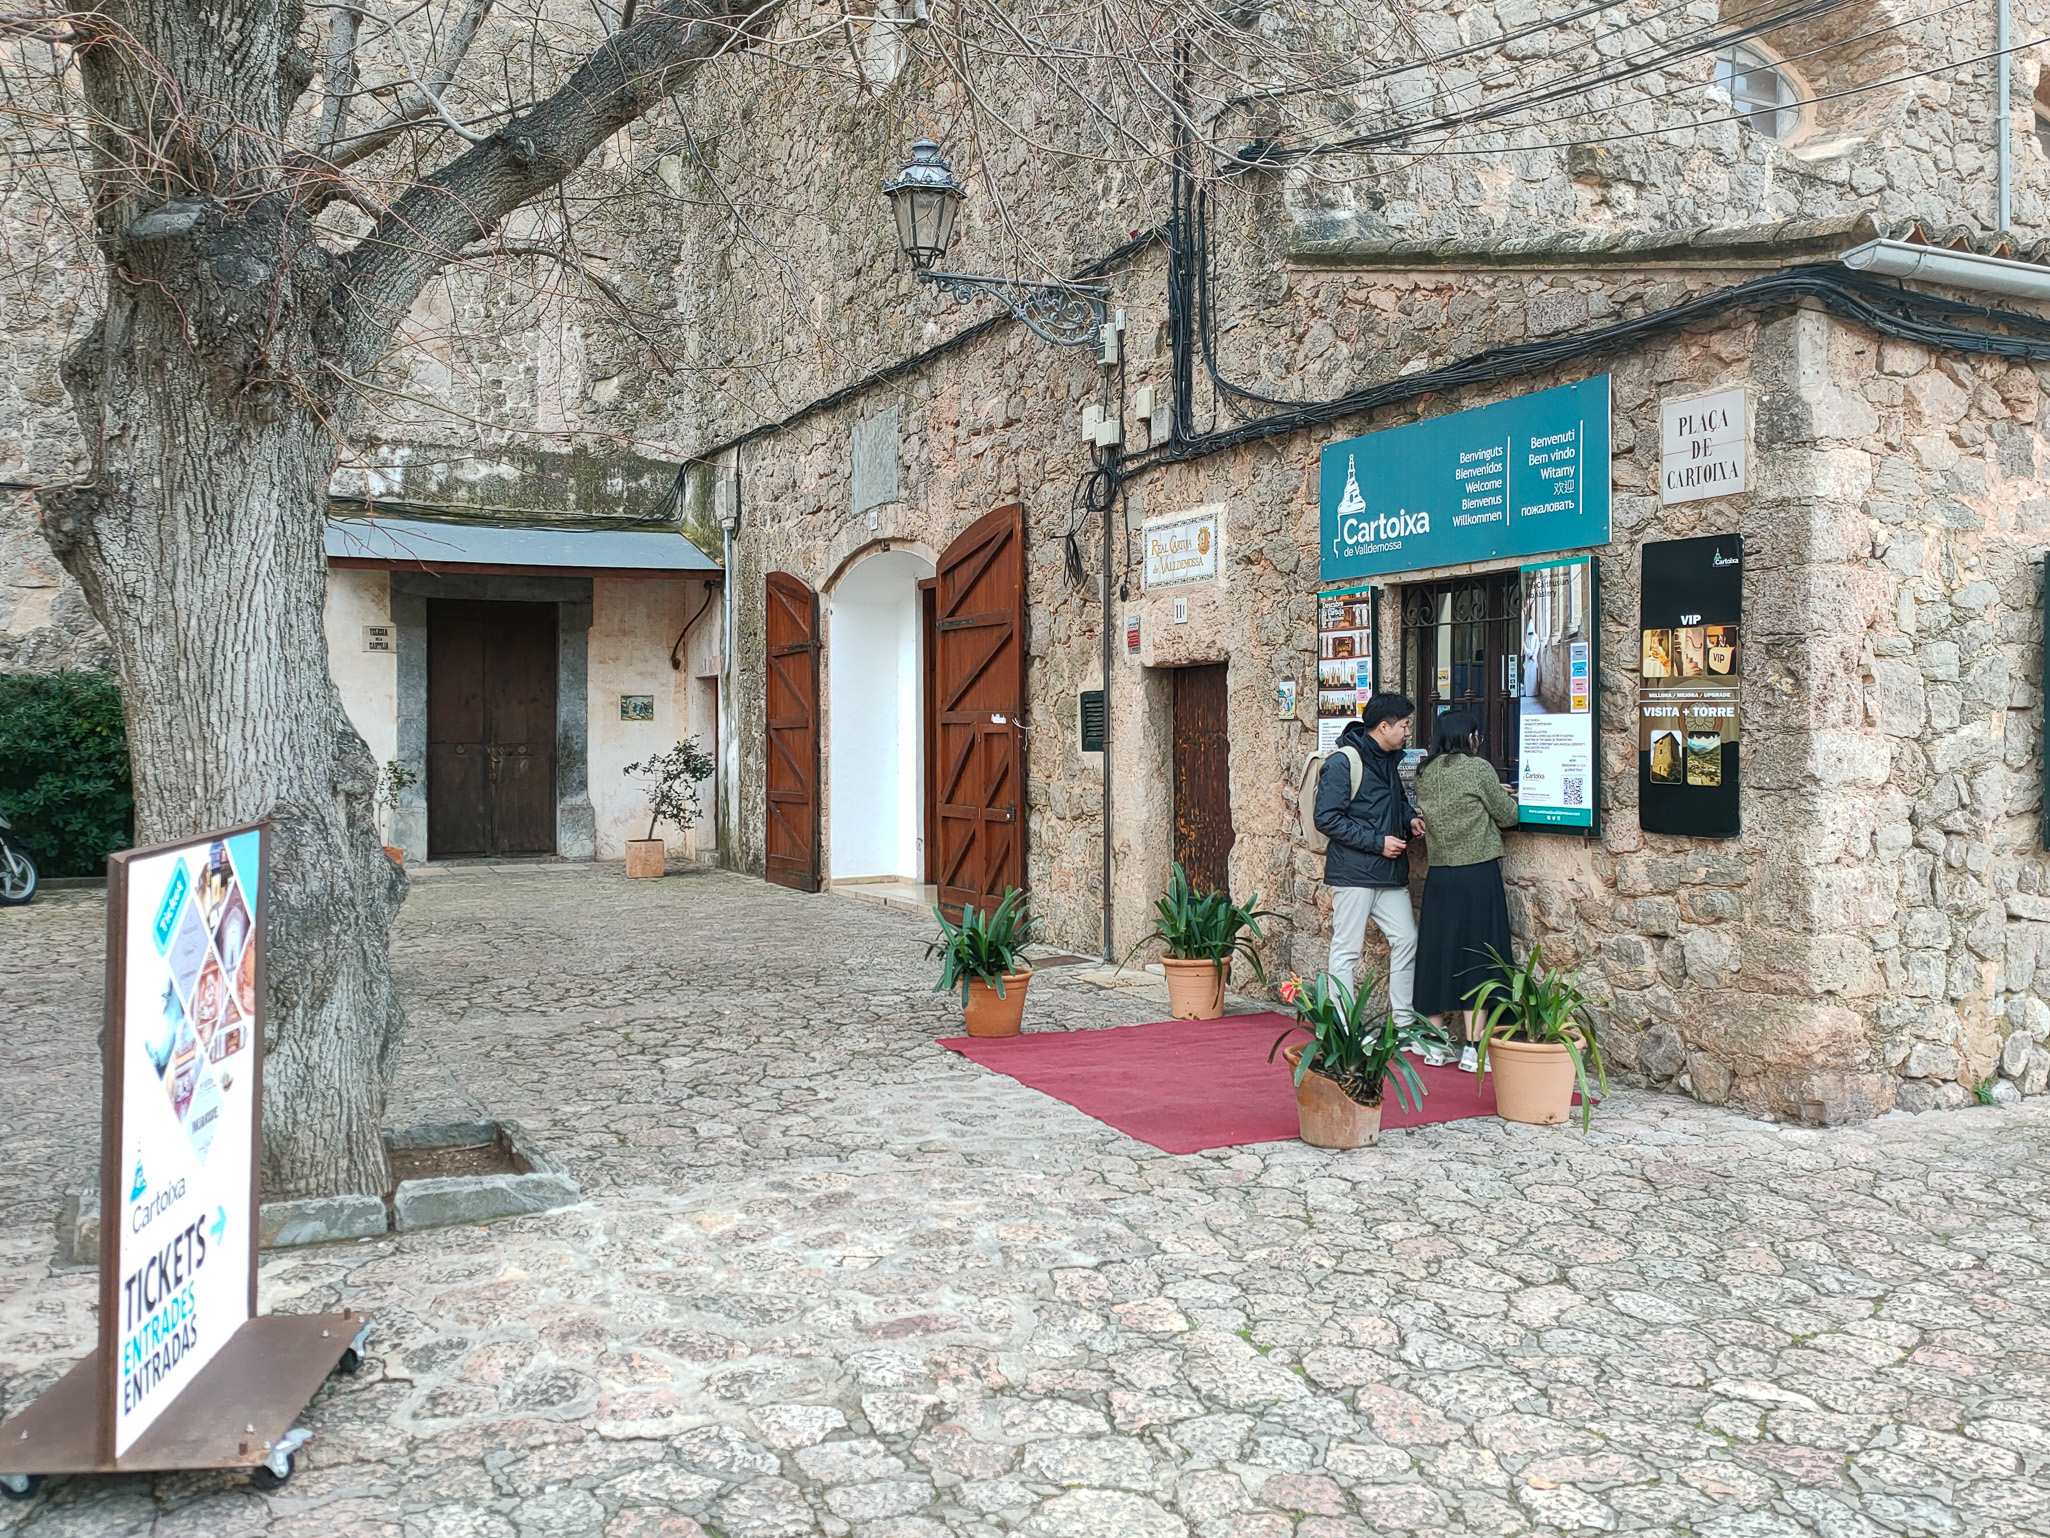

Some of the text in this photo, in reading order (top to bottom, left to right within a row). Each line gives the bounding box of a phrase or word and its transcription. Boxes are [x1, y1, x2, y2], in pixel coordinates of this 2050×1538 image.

[1678, 408, 1728, 437] PLAÇA
[1530, 429, 1575, 449] Benvenuti
[1460, 446, 1503, 464] Benvinguts
[1528, 446, 1575, 466] Bem vindo
[1691, 437, 1713, 460] DE
[1455, 462, 1503, 480] Bienvenidos
[1541, 465, 1575, 480] Witamy
[1667, 460, 1739, 489] CARTOIXA
[1465, 479, 1502, 493] Welcome
[1553, 479, 1575, 495] 欢迎
[1461, 495, 1502, 510] Bienvenus
[1521, 500, 1575, 516] пожаловать
[1343, 509, 1430, 545] Cartoixa
[1452, 511, 1502, 527] Willkommen
[1344, 541, 1402, 557] de Valldemossa
[1715, 557, 1739, 565] Cartoixa
[1680, 614, 1701, 625] VIP
[1713, 653, 1725, 663] VIP
[1643, 707, 1735, 717] VISITA + TORRE
[132, 1177, 186, 1234] Cartoixa
[124, 1214, 206, 1333] TICKETS
[124, 1280, 195, 1377] ENTRADES
[124, 1313, 198, 1417] ENTRADAS
